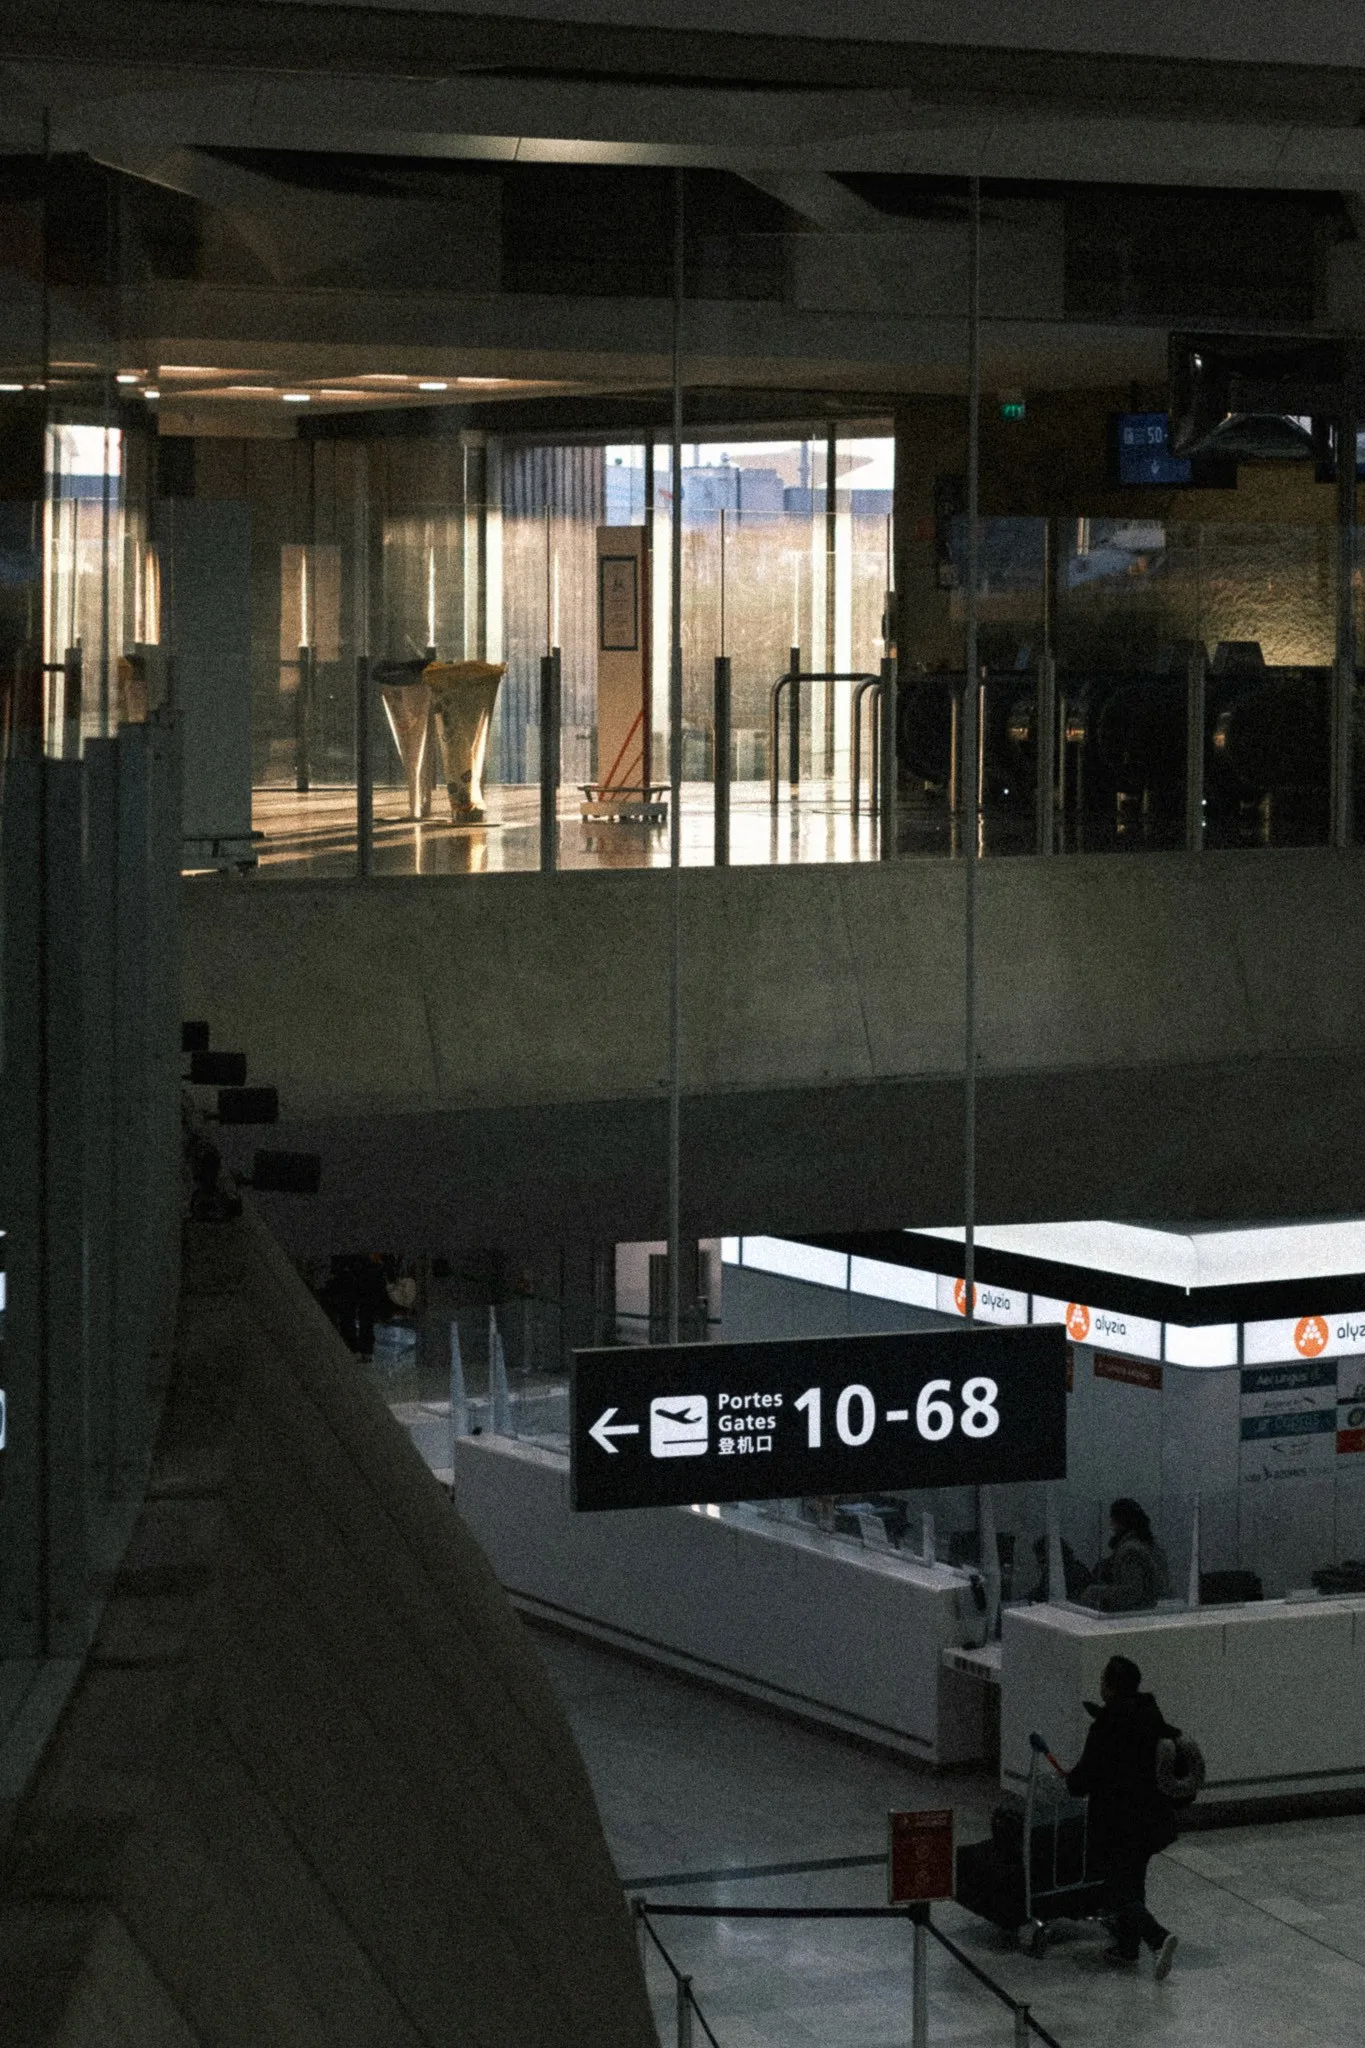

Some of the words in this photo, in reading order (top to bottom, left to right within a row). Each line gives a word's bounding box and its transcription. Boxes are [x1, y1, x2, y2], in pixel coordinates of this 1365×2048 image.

[981, 1291, 1011, 1312] alyzia
[1095, 1315, 1127, 1336] alyzia
[718, 1392, 783, 1410] Portes
[794, 1376, 1000, 1449] 10-68
[718, 1415, 776, 1432] Gates
[717, 1435, 773, 1456] 登机口
